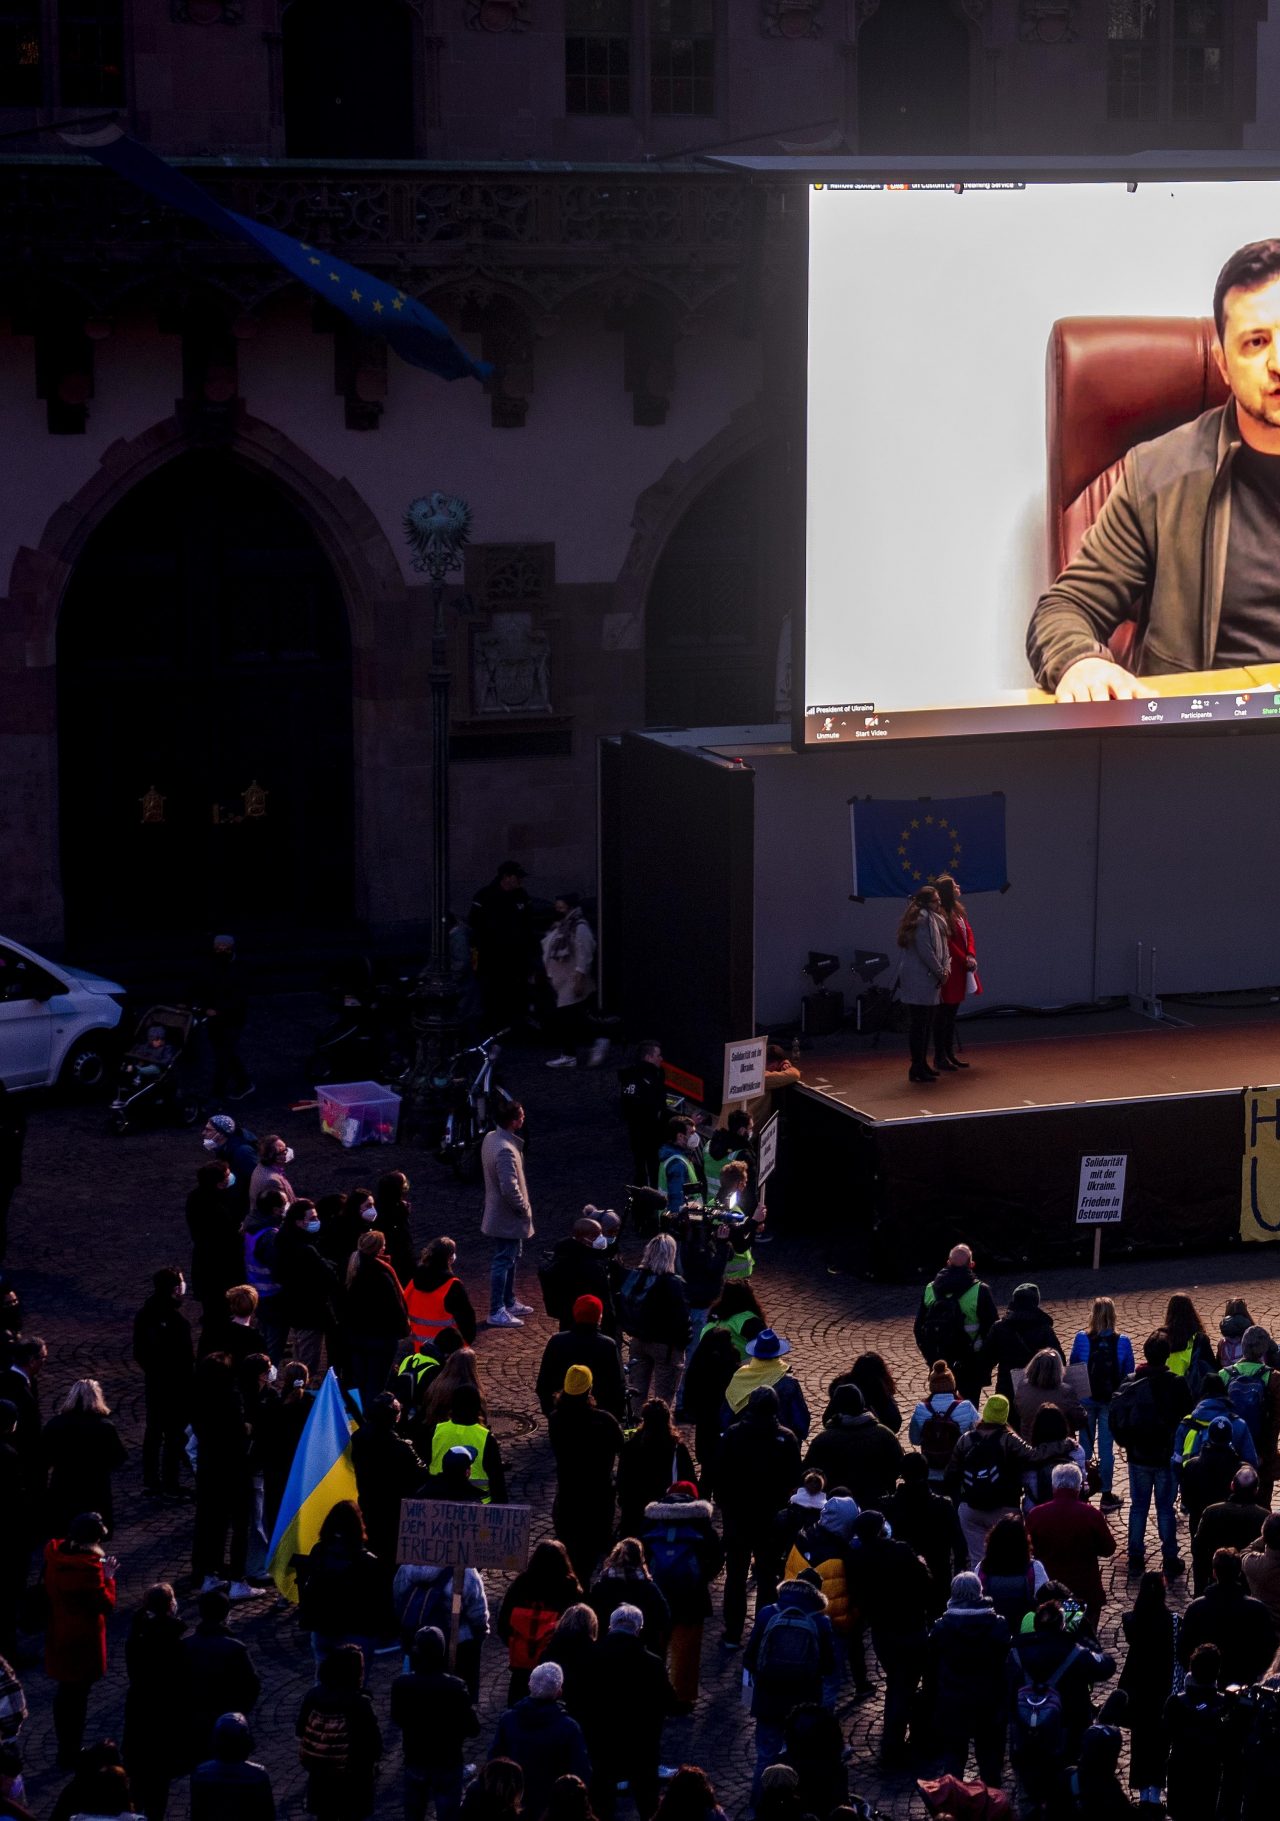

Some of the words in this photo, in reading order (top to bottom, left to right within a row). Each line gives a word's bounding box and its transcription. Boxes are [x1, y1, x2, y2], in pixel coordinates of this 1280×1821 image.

[816, 705, 843, 714] President
[843, 704, 851, 713] of
[851, 703, 874, 713] Ukraine
[1141, 713, 1164, 722] Security
[1180, 711, 1213, 720] Participants
[816, 732, 840, 740] Unmute
[855, 730, 870, 738] Start
[870, 729, 888, 737] Video
[1084, 1157, 1124, 1168] Solidarität
[1089, 1170, 1103, 1179] mit
[1103, 1169, 1117, 1179] der
[1086, 1181, 1117, 1191] Ukraine.
[1080, 1196, 1111, 1208] Frieden
[1111, 1196, 1120, 1207] in
[1077, 1209, 1120, 1220] Osteuropa.
[399, 1536, 470, 1565] FRIEDEN
